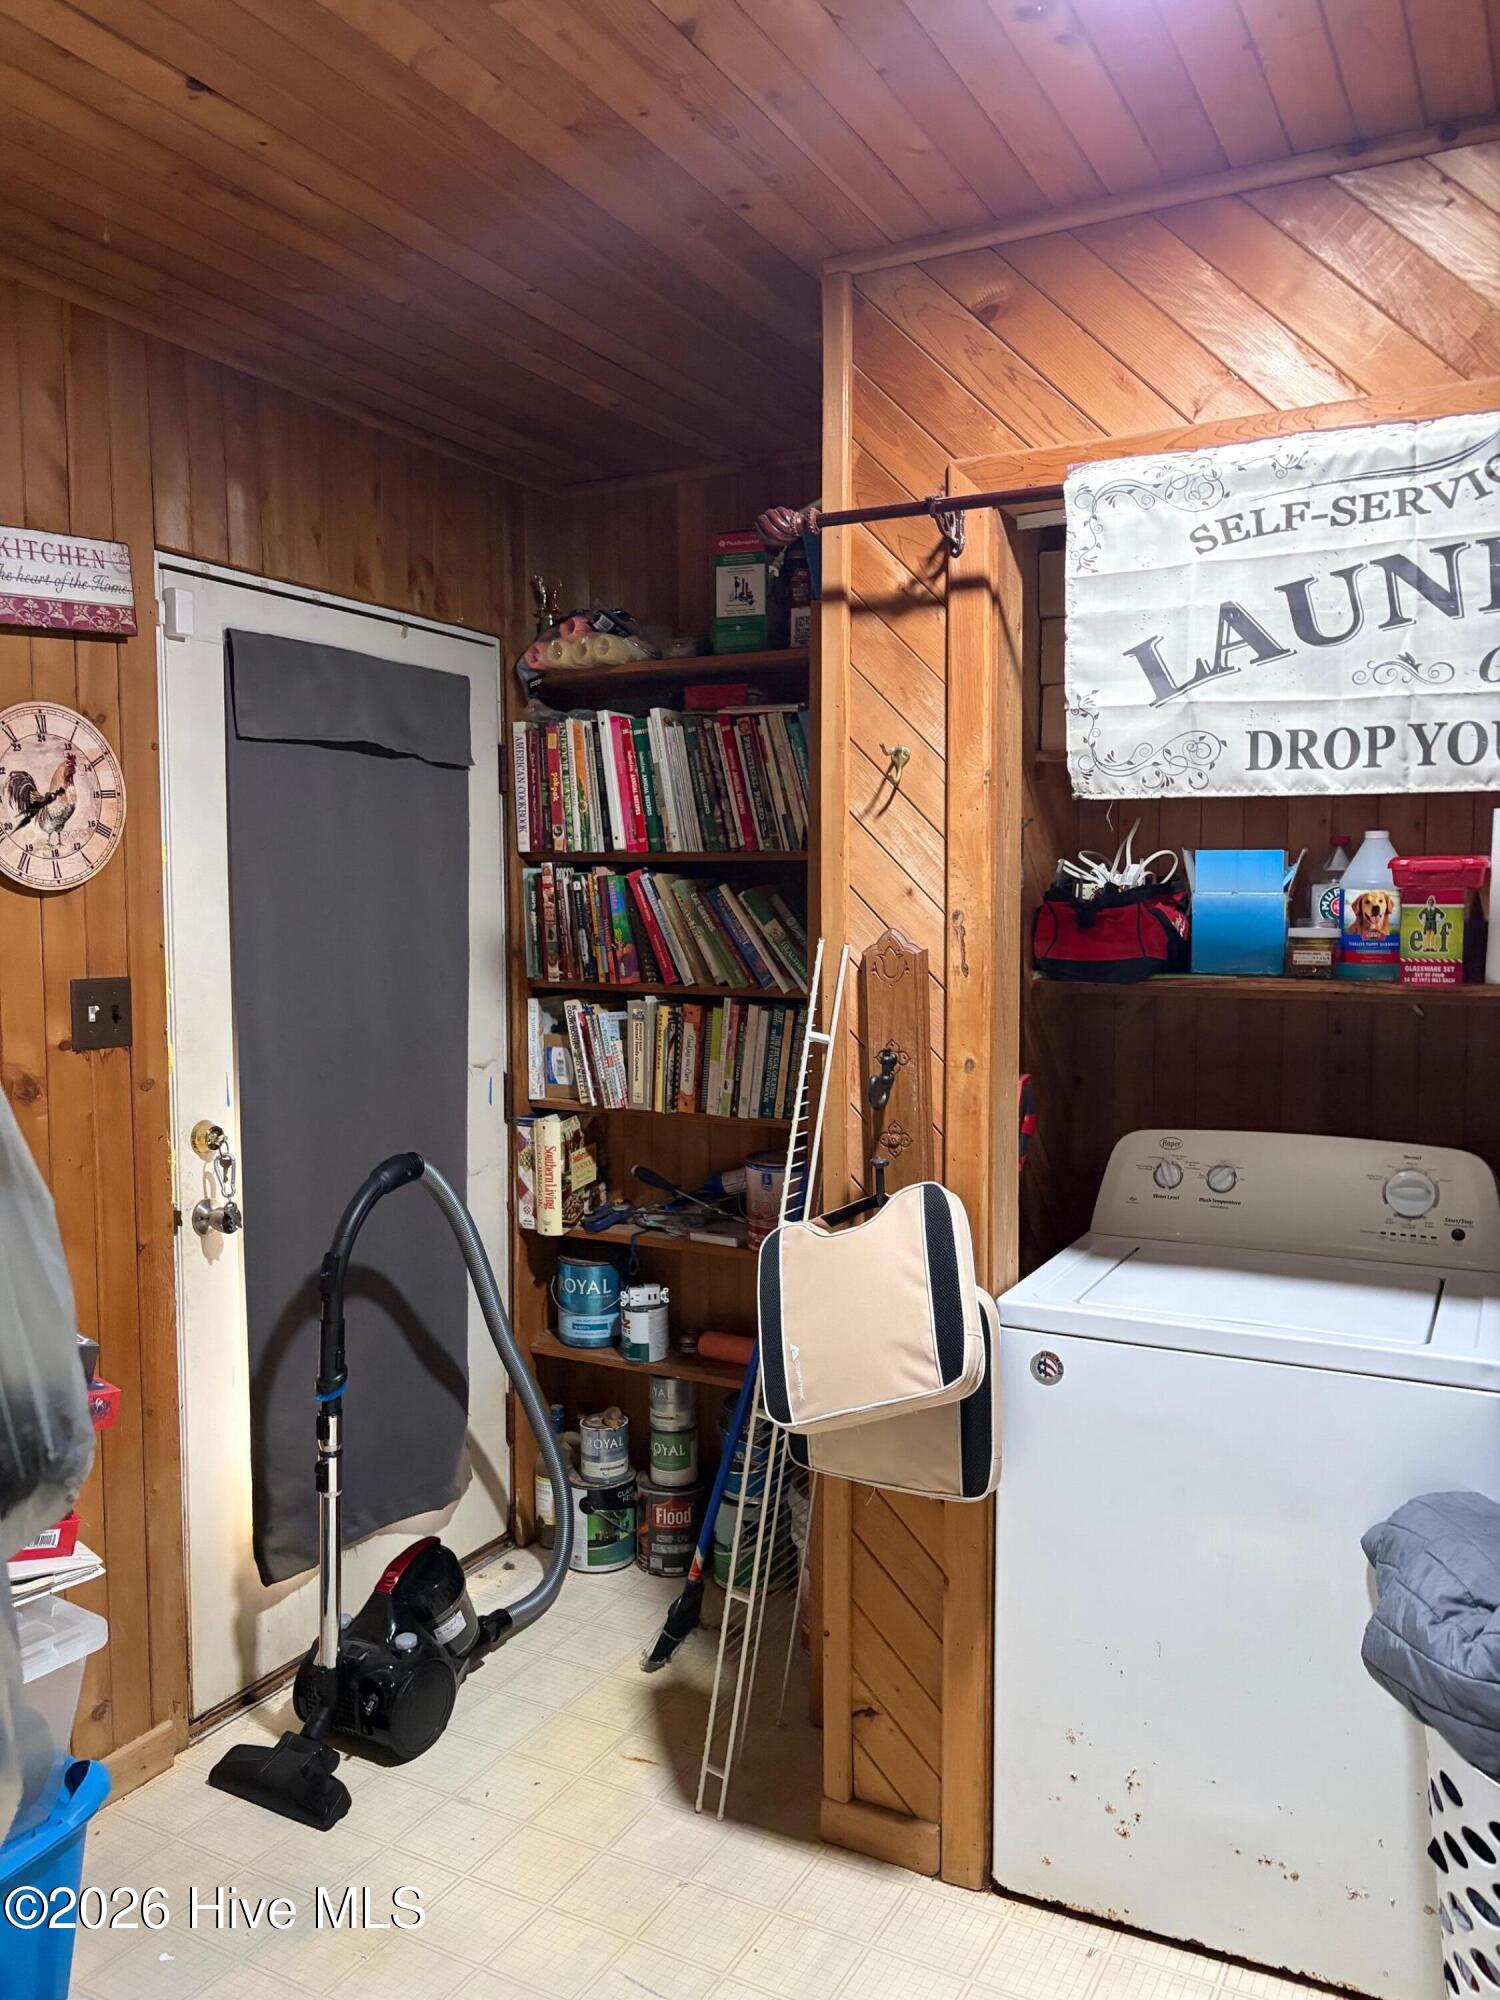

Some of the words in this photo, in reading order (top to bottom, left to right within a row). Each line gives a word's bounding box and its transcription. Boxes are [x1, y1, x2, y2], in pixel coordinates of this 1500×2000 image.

[0, 563, 13, 580] he
[16, 566, 51, 583] heart
[54, 571, 71, 594] of
[70, 572, 88, 590] the
[514, 735, 525, 783] AMERICAN
[1245, 724, 1396, 771] DROP
[740, 734, 762, 788] PRACTICAL
[752, 789, 767, 820] PALEO
[516, 786, 527, 832] COOKBOOK
[644, 794, 653, 817] RECIPES
[88, 820, 95, 828] 16
[1404, 965, 1442, 973] GLASSWARE
[772, 1047, 780, 1069] FRUGAL
[769, 1070, 778, 1098] GOURMET
[544, 1145, 557, 1182] Southern
[543, 1182, 557, 1210] Living
[652, 1442, 687, 1457] OYAL
[655, 1507, 692, 1525] Flood
